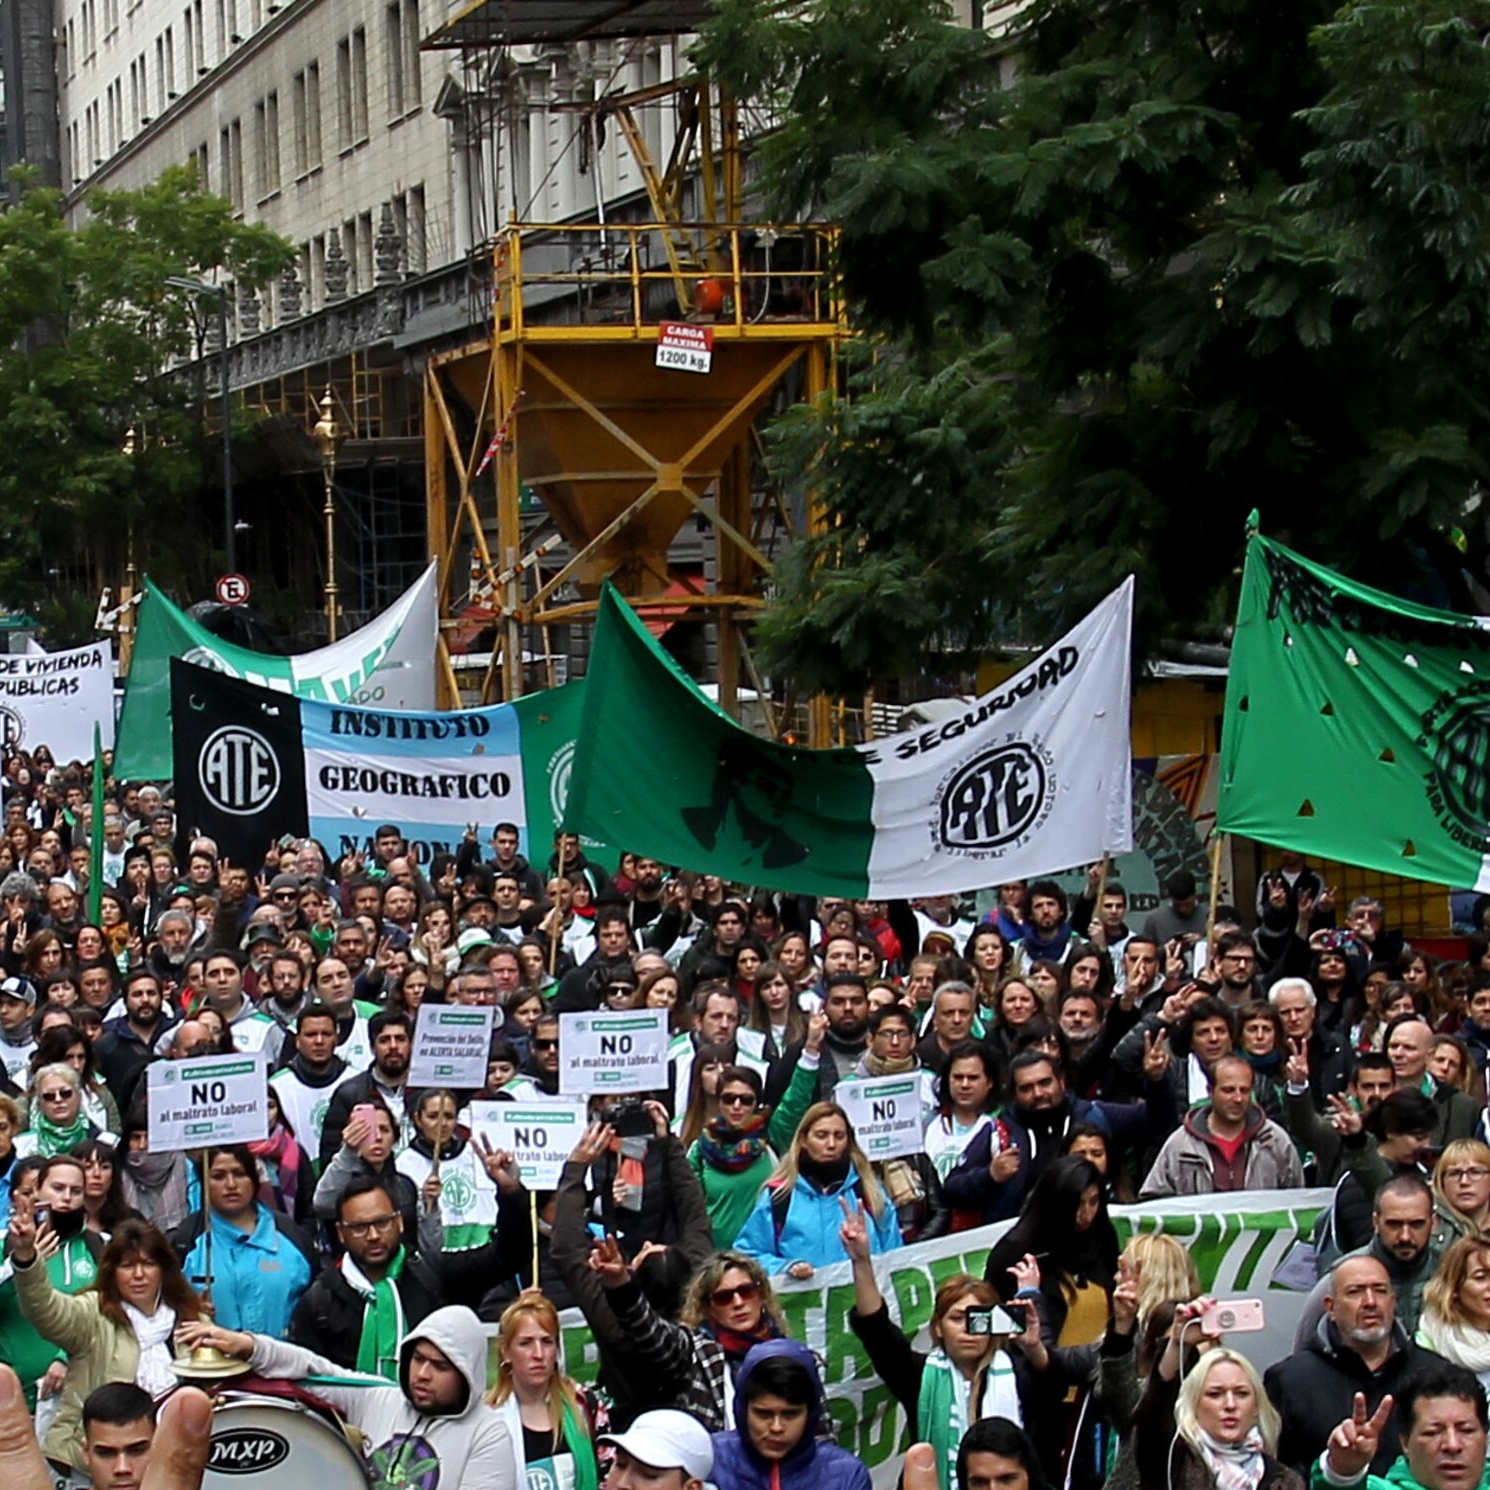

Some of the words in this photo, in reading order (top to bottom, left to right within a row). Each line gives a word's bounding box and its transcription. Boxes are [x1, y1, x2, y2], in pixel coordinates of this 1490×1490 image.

[662, 336, 707, 351] MAXIMA
[666, 325, 705, 340] CARGA
[658, 350, 687, 366] 1200
[25, 651, 103, 674] VIVIENDA
[895, 646, 1080, 760] SEGURIDAD
[328, 709, 491, 740] INSTITUTO
[206, 730, 271, 808] ATE
[319, 765, 510, 799] GEOGRAFICO
[950, 753, 1035, 840] ATE
[601, 1034, 633, 1055] NO
[627, 1053, 659, 1066] laboral
[192, 1081, 226, 1106] NO
[159, 1110, 170, 1123] al
[172, 1106, 219, 1121] maltrato
[220, 1100, 258, 1116] laboral
[872, 1100, 896, 1121] NO
[514, 1128, 547, 1148] NO
